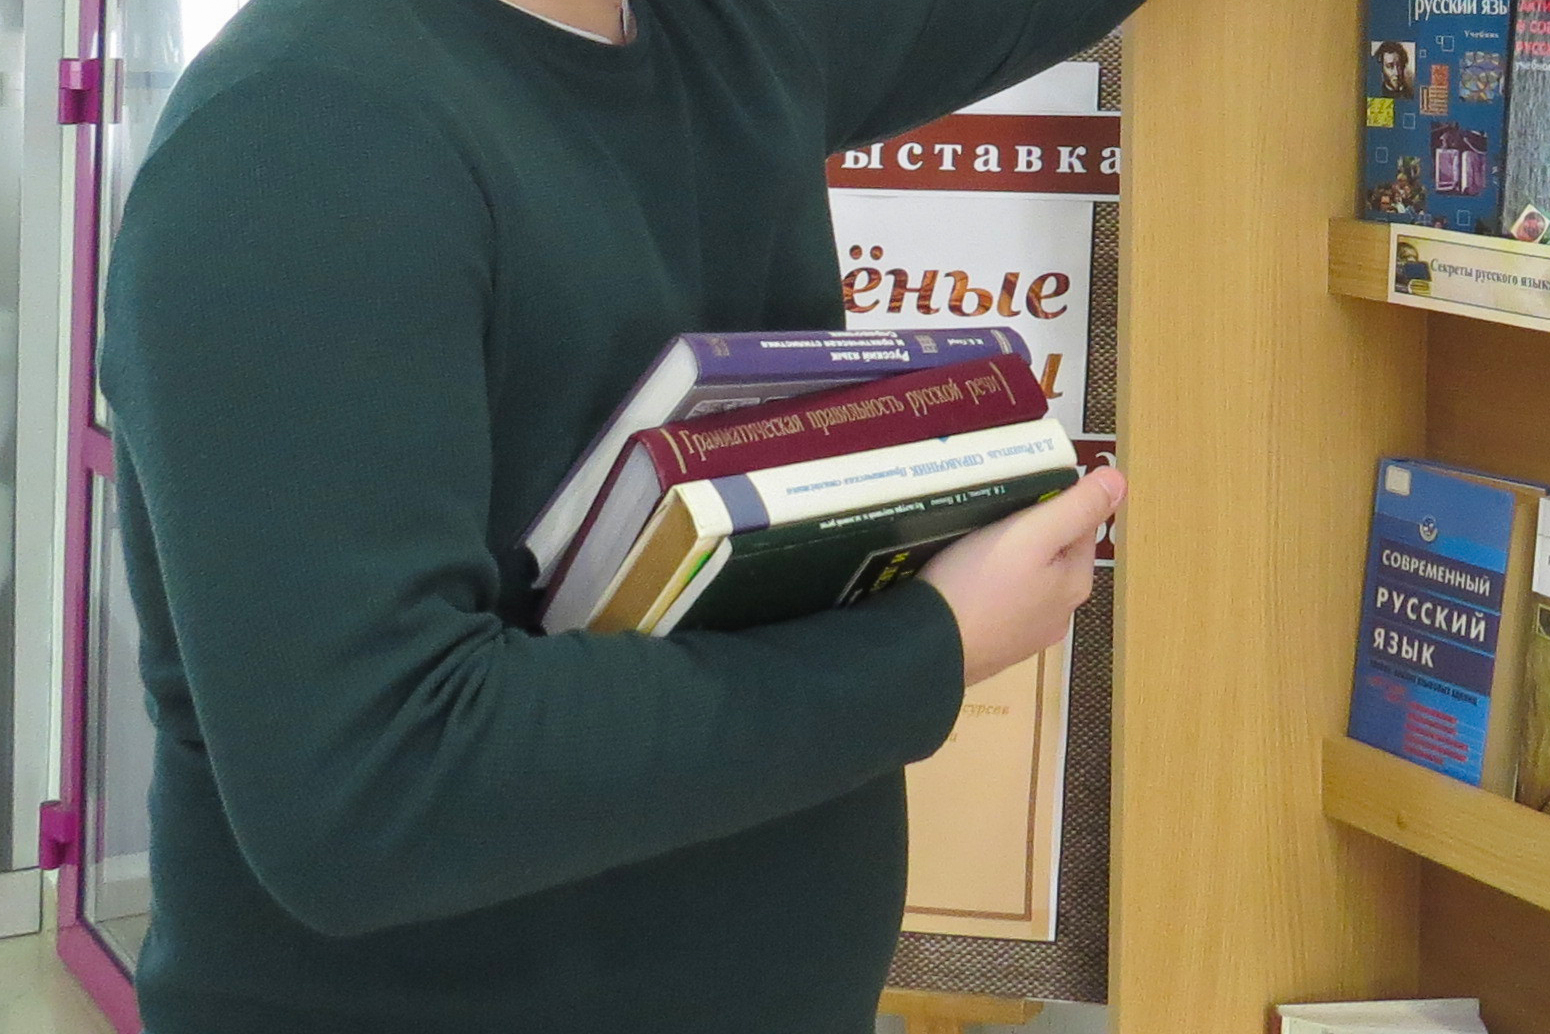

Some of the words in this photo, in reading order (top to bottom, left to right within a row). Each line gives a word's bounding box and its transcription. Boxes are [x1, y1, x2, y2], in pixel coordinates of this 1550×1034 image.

[1431, 257, 1474, 279] Секреты
[1475, 268, 1518, 287] русского
[830, 349, 861, 362] язык
[863, 349, 910, 363] Русский
[679, 413, 806, 462] Грамматическая
[807, 395, 905, 436] правильность
[905, 378, 964, 417] русской
[964, 373, 1004, 406] речи
[910, 453, 985, 478] СПРАВОЧНИК
[1382, 550, 1491, 597] СОВРЕМЕННЫЙ
[1376, 587, 1486, 643] РУССКИЙ
[1373, 627, 1436, 668] ЯЗЫК
